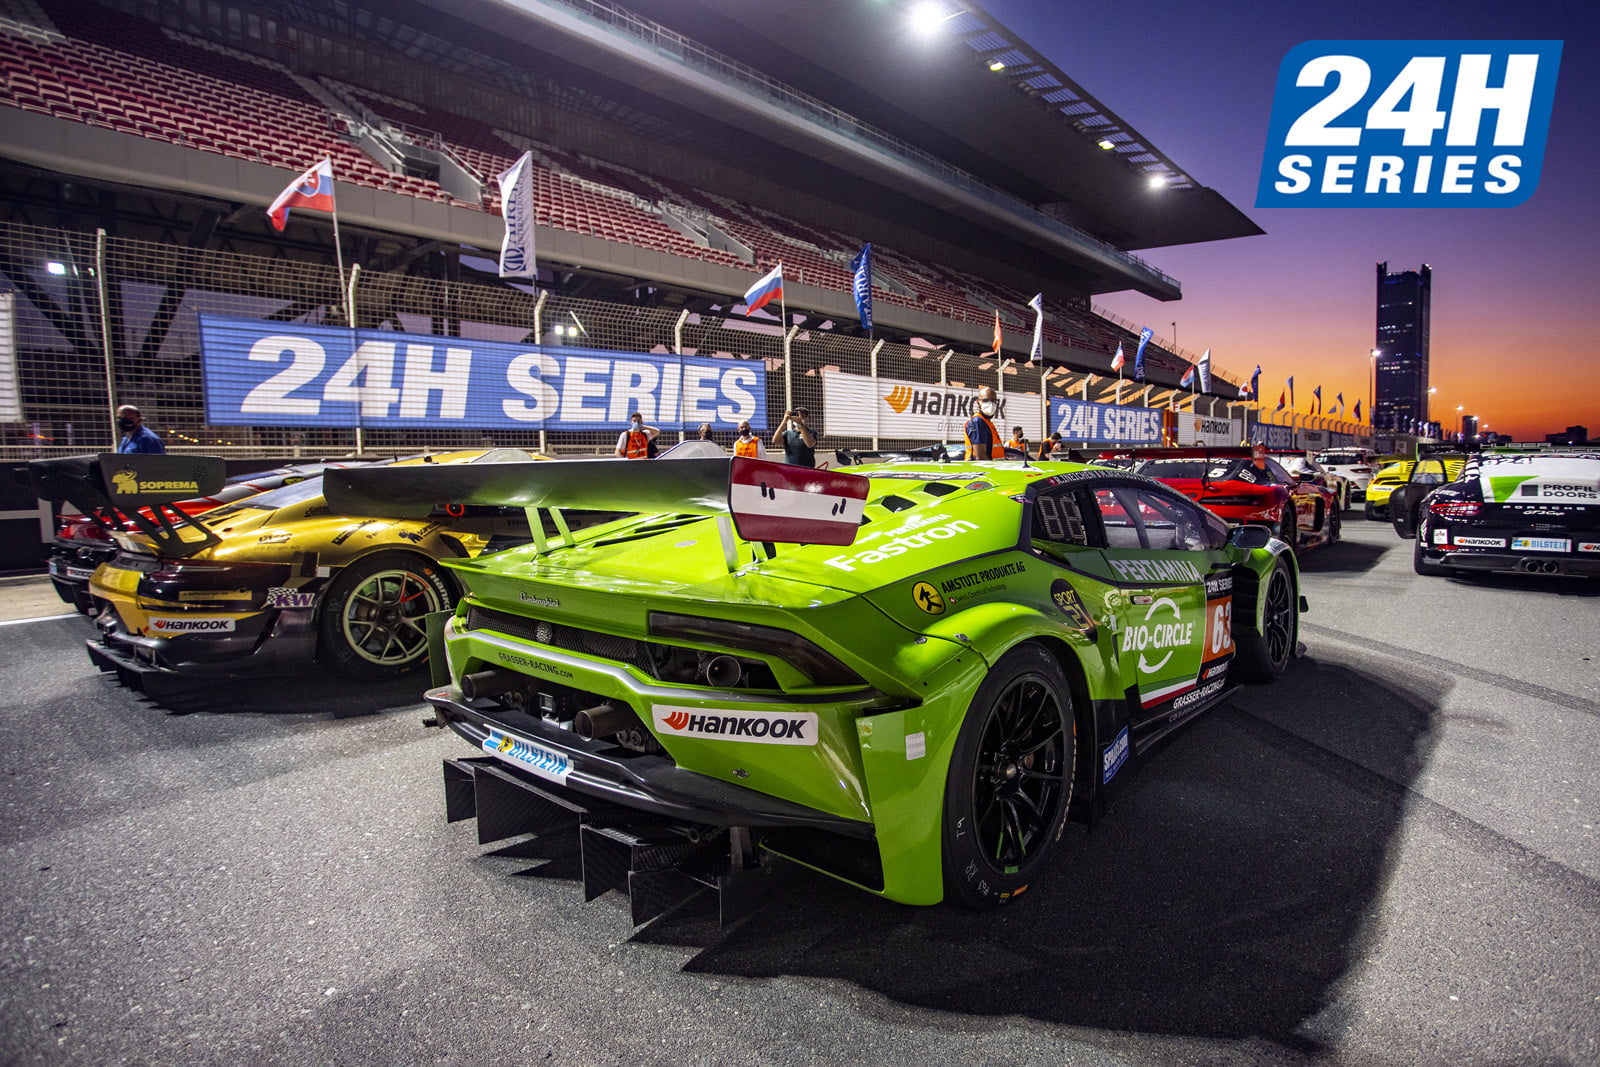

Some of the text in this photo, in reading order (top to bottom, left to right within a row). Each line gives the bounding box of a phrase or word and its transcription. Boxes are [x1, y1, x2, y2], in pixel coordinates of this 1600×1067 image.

[241, 336, 757, 423] 24H SERIES
[911, 390, 1007, 420] HANKOK
[1056, 403, 1160, 441] 24H SERIES
[139, 481, 198, 489] SOPREMA
[1543, 484, 1597, 493] PROFIL
[1543, 491, 1597, 499] DOORS
[823, 519, 979, 572] Fastron
[1530, 540, 1567, 549] BILSTEIN
[941, 560, 1026, 594] AMSTUTZ PRODUKTE AG
[1108, 559, 1202, 582] PERTAMINA
[275, 594, 314, 607] KW
[1053, 589, 1077, 606] SPORT
[1122, 622, 1193, 652] BIO-CIRCLE
[508, 740, 568, 775] BILSTEIN
